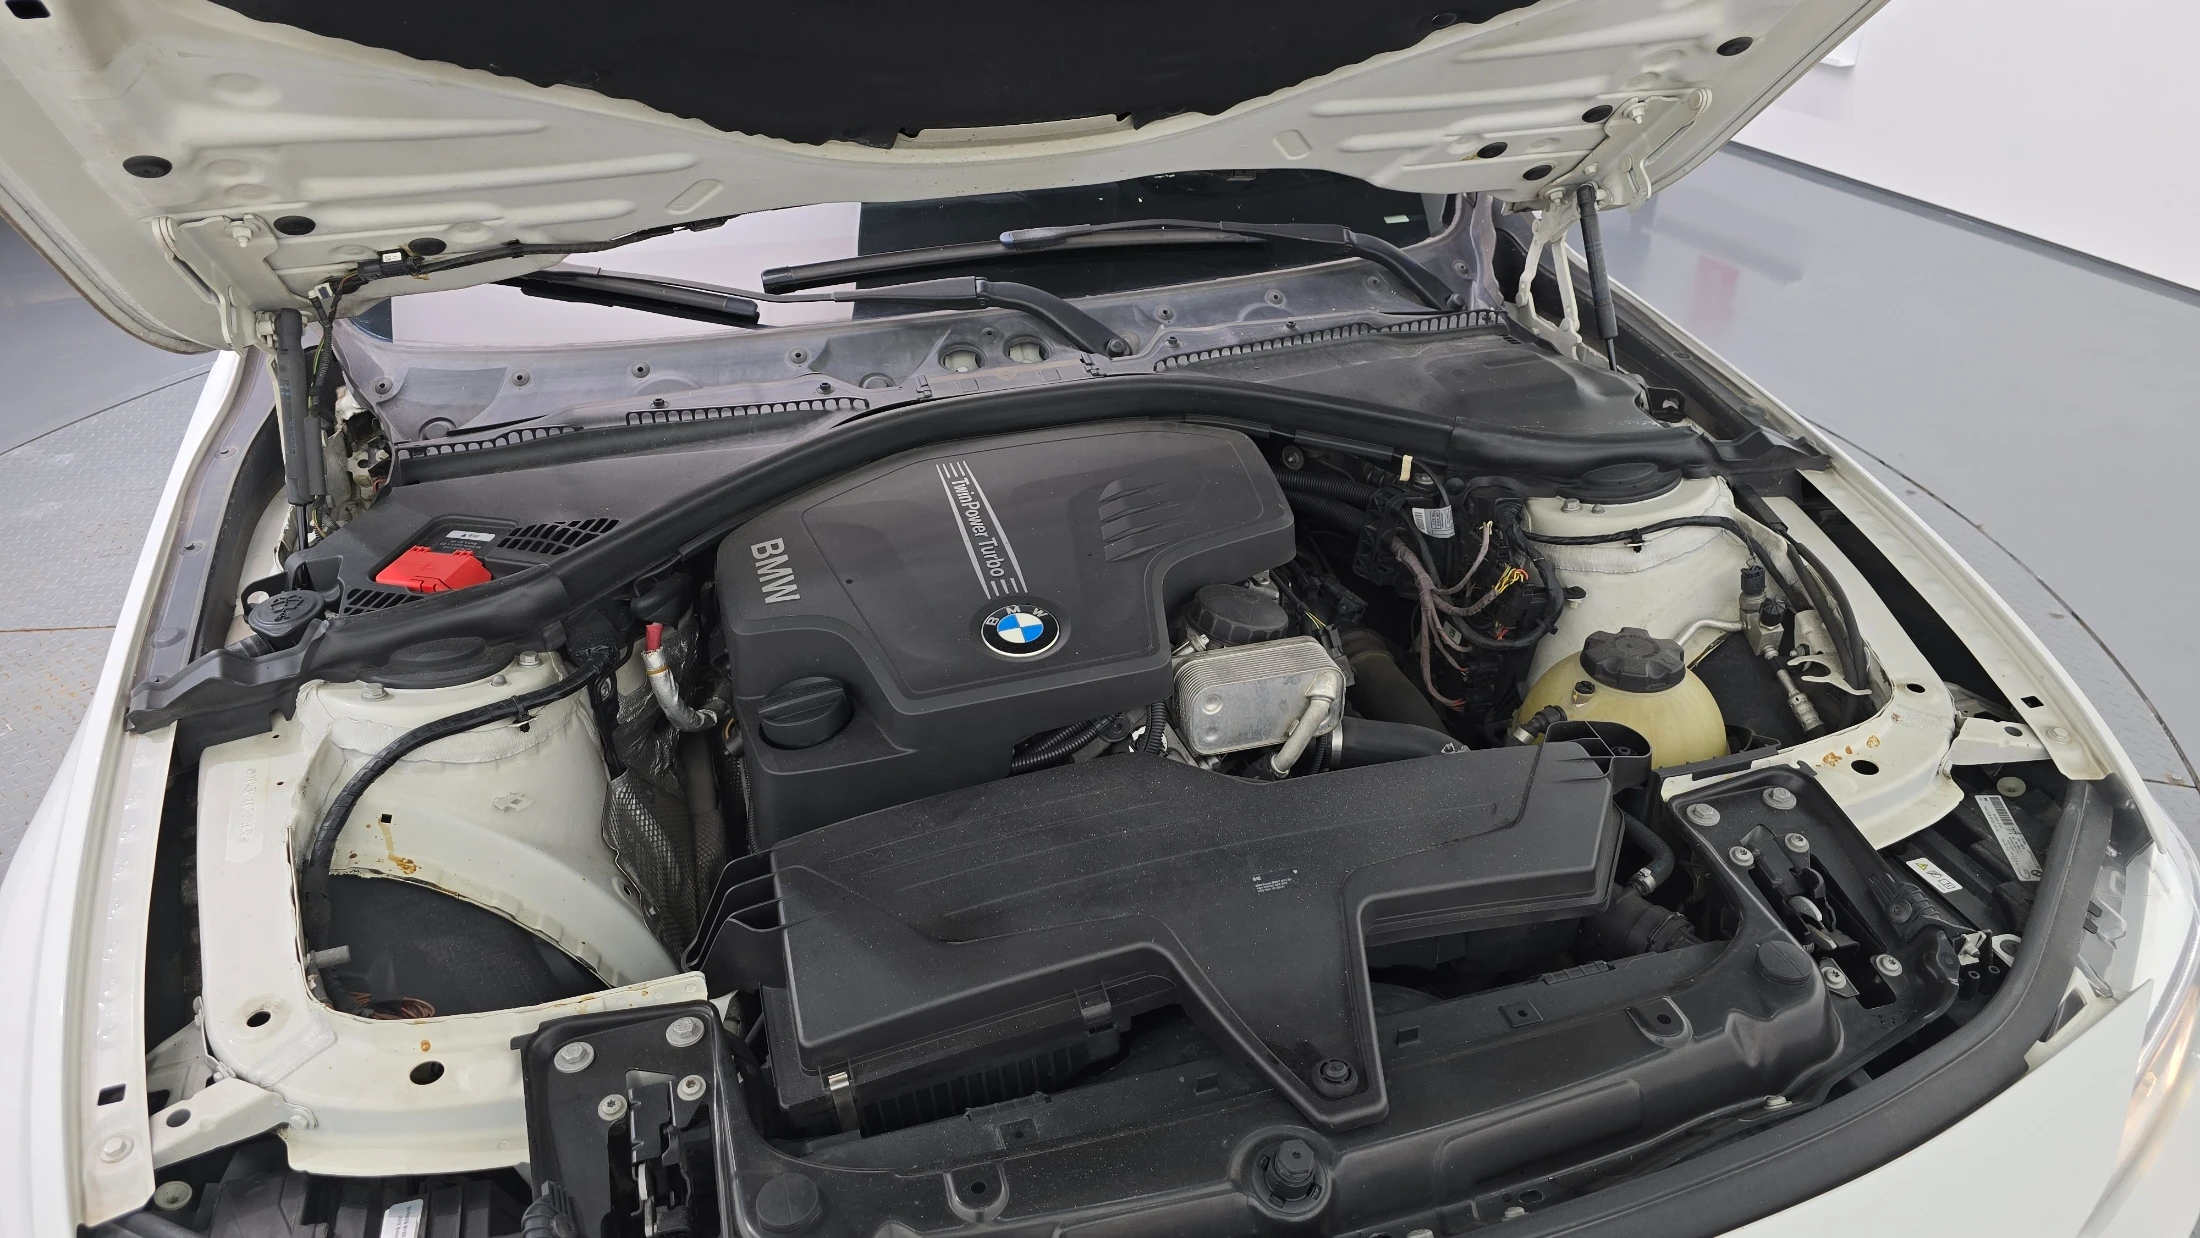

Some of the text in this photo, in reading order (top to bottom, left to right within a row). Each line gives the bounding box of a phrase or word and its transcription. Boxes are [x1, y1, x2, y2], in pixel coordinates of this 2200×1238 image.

[952, 477, 1005, 577] TwinPower Turbo
[751, 537, 801, 604] BMW
[985, 605, 1049, 627] BMW
